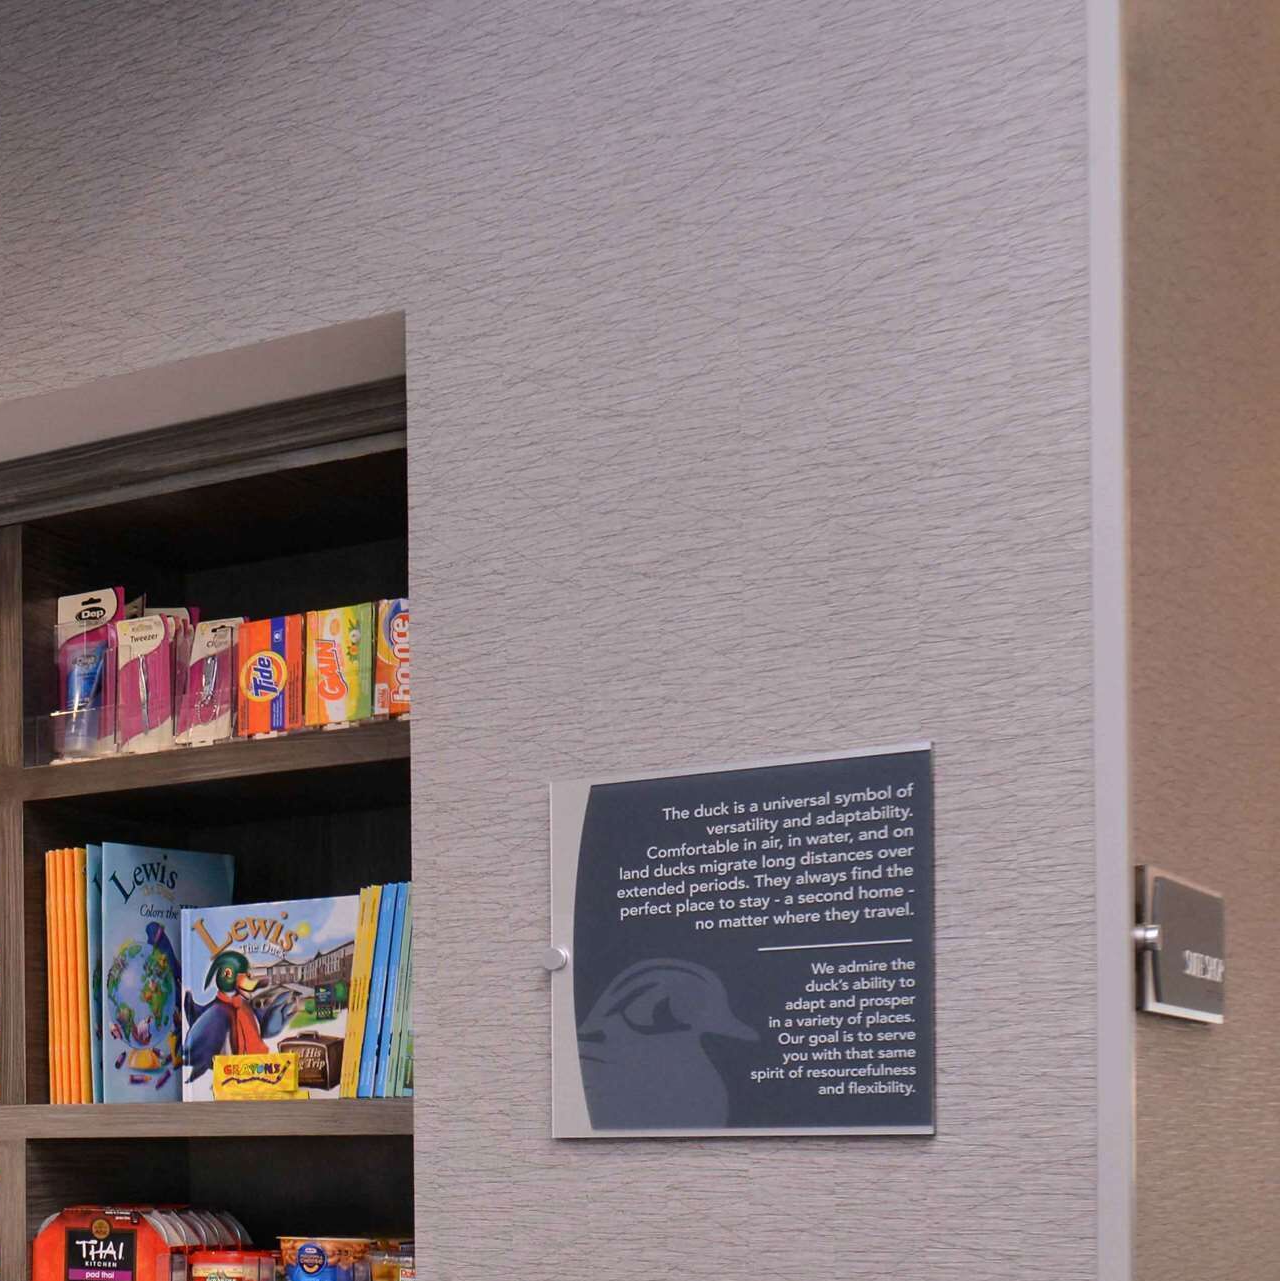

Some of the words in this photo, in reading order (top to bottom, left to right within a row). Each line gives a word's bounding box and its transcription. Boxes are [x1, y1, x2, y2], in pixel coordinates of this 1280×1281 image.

[81, 610, 104, 620] Dep
[130, 633, 159, 644] Tweezer
[253, 655, 273, 699] Tide
[662, 806, 689, 820] The
[693, 801, 729, 817] duck
[733, 801, 745, 813] is
[749, 802, 758, 812] a
[762, 791, 829, 811] universal
[834, 785, 891, 807] symbol
[896, 782, 914, 798] of
[706, 817, 778, 835] versatility
[782, 812, 811, 828] and
[816, 804, 913, 826] adaptability.
[646, 839, 739, 859] Comfortable
[743, 838, 756, 850] in
[761, 835, 783, 849] air,
[788, 834, 801, 847] in
[805, 832, 853, 845] water,
[858, 824, 888, 840] and
[893, 827, 913, 837] on
[619, 864, 649, 880] land
[653, 861, 695, 877] ducks
[699, 858, 757, 875] migrate
[762, 854, 795, 870] long
[800, 850, 873, 865] distances
[877, 846, 914, 858] over
[109, 854, 179, 905] Lewis
[616, 880, 684, 898] extended
[689, 876, 749, 897] periods.
[753, 873, 791, 889] They
[795, 870, 847, 886] always
[850, 864, 881, 880] find
[885, 863, 913, 877] the
[620, 901, 671, 920] perfect
[675, 898, 714, 916] place
[718, 898, 735, 909] to
[739, 896, 770, 910] stay
[784, 895, 793, 904] a
[797, 886, 853, 904] second
[858, 885, 904, 899] home
[140, 904, 166, 919] Colors
[166, 905, 179, 920] the
[695, 919, 714, 929] no
[718, 915, 769, 928] matter
[772, 910, 820, 924] where
[823, 907, 859, 923] they
[863, 901, 914, 918] travel.
[192, 910, 301, 962] Lewis
[241, 942, 259, 954] The
[811, 962, 834, 974] We
[838, 959, 887, 973] admire
[890, 957, 915, 970] the
[805, 978, 849, 992] duck's
[852, 976, 896, 991] ability
[898, 977, 915, 987] to
[785, 997, 825, 1011] adapt
[829, 994, 855, 1008] and
[859, 996, 915, 1009] prosper
[769, 1016, 780, 1027] in
[784, 1018, 792, 1027] a
[796, 1011, 843, 1028] variety
[847, 1009, 863, 1024] of
[866, 1008, 915, 1027] places.
[778, 1032, 805, 1044] Our
[808, 1030, 839, 1046] goal
[842, 1030, 854, 1042] is
[857, 1031, 873, 1041] to
[876, 1031, 916, 1041] serve
[305, 1047, 322, 1058] His
[782, 1052, 808, 1064] you
[811, 1047, 841, 1060] with
[845, 1047, 874, 1059] that
[877, 1048, 916, 1058] same
[223, 1062, 282, 1076] CRAYONS
[305, 1058, 327, 1071] Trip
[750, 1067, 784, 1082] spirit
[788, 1065, 803, 1078] of
[806, 1063, 916, 1077] resourcefulness
[818, 1081, 844, 1094] and
[847, 1080, 915, 1096] flexibility.
[75, 1240, 125, 1261] THAI
[85, 1260, 118, 1268] KITCHEN
[85, 1271, 101, 1280] pad
[101, 1270, 115, 1279] thai
